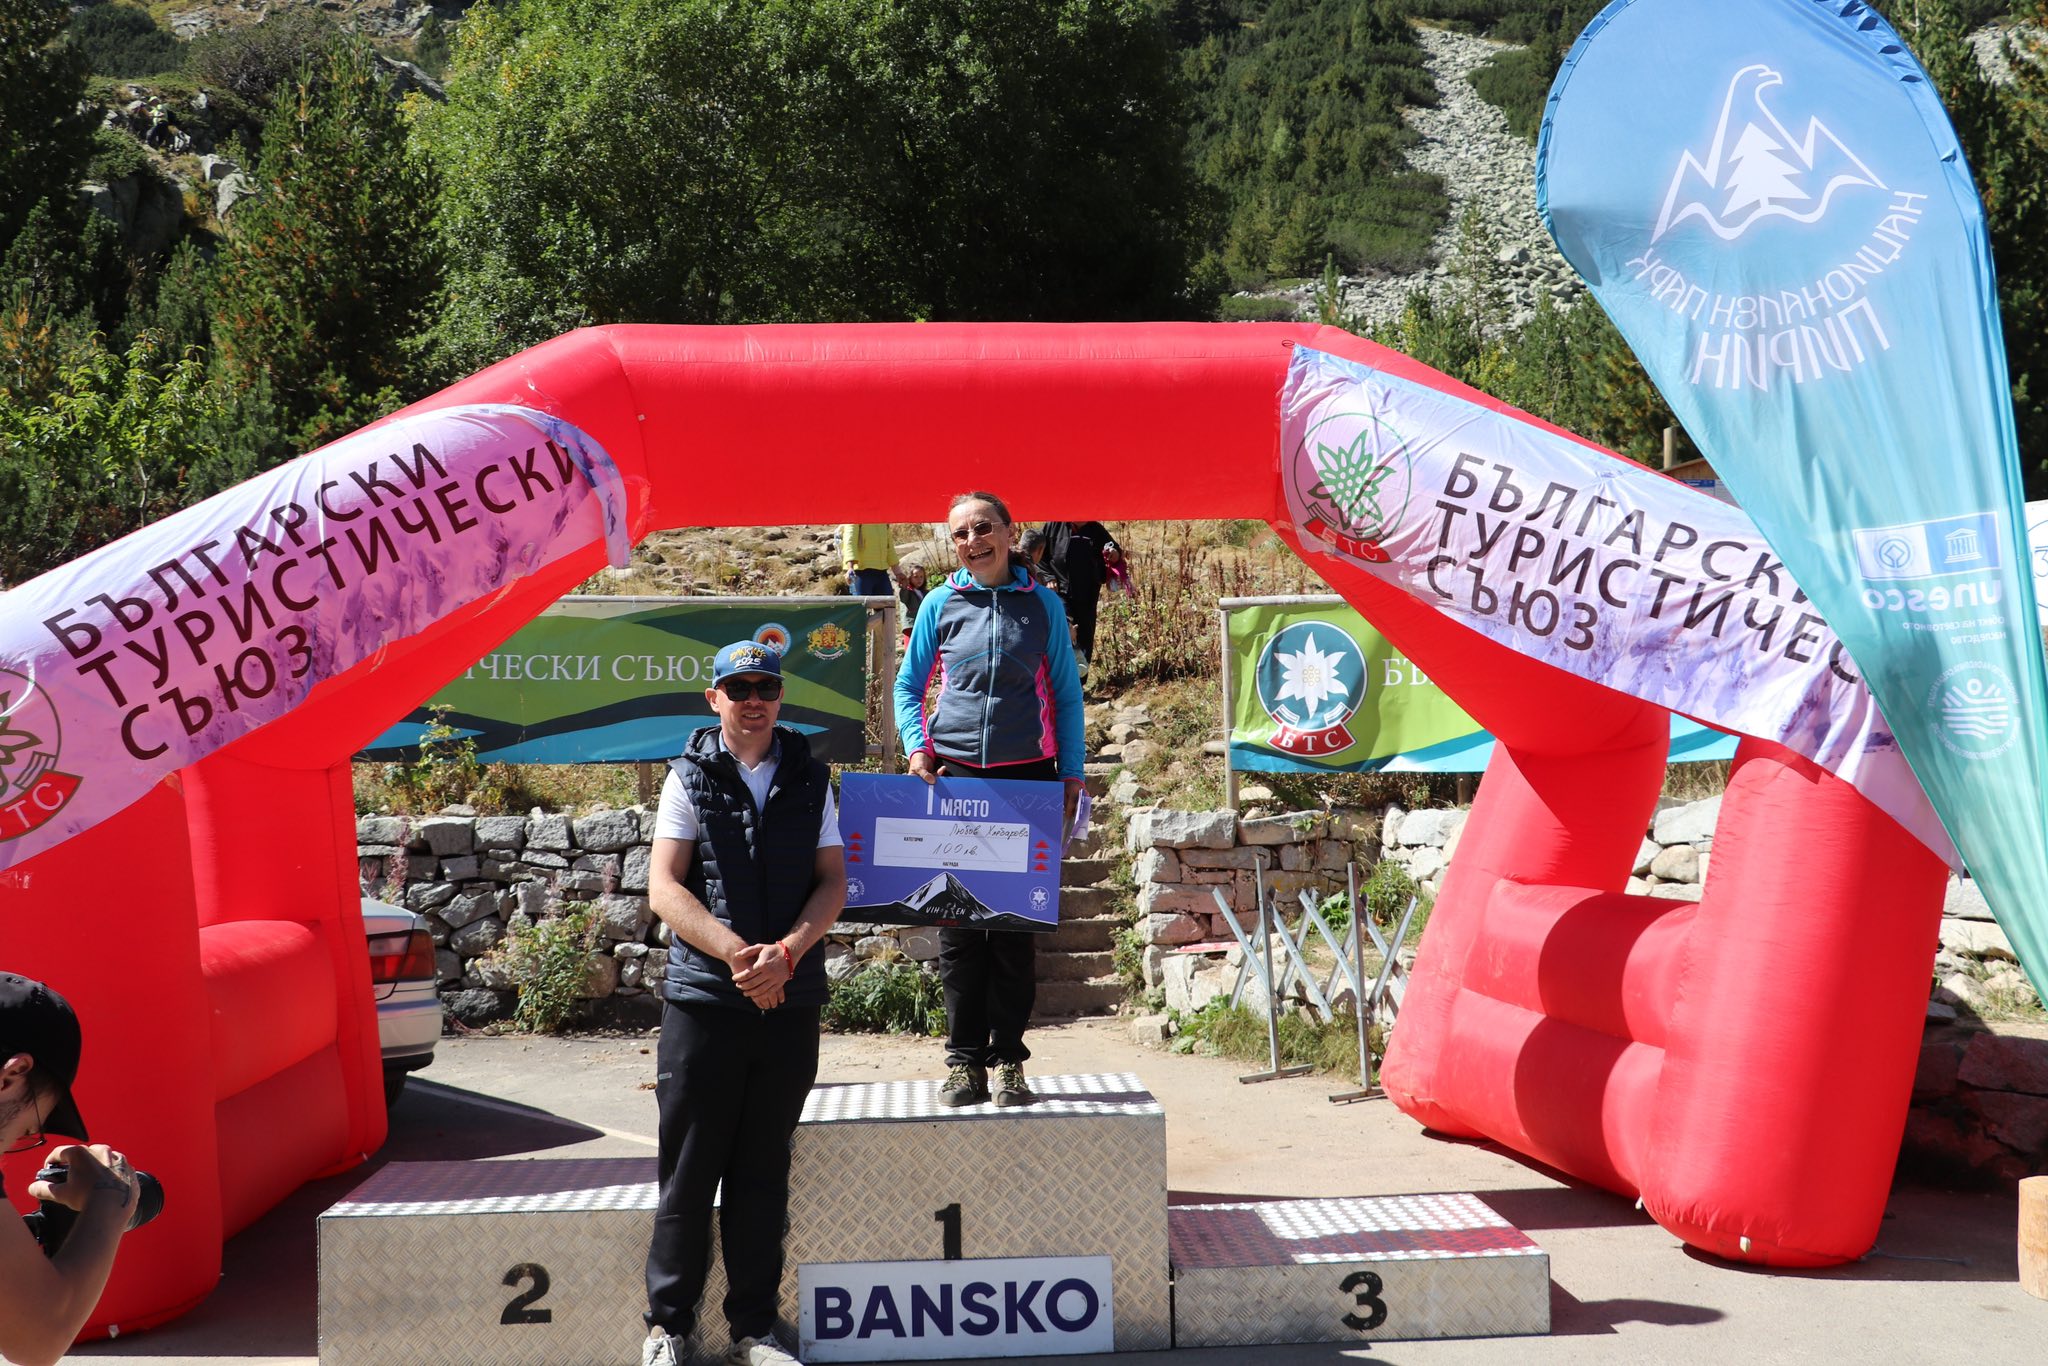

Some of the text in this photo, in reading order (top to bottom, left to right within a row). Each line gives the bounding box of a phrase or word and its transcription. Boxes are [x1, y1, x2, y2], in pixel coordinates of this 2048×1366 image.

[42, 442, 449, 660] БЪЛГАРСКИ
[1444, 451, 1808, 604] БЪЛГАРСК
[1426, 554, 1600, 651] СЪЮЗ
[121, 623, 313, 762] СЪЮЗ
[1382, 658, 1434, 686] БЪ
[1280, 730, 1341, 752] БТС
[0, 782, 63, 836] ТС
[940, 798, 989, 818] МЯСТО
[935, 1203, 962, 1260] 1
[500, 1264, 551, 1325] 2
[814, 1278, 1099, 1340] BANSKO
[1339, 1271, 1387, 1332] 3
